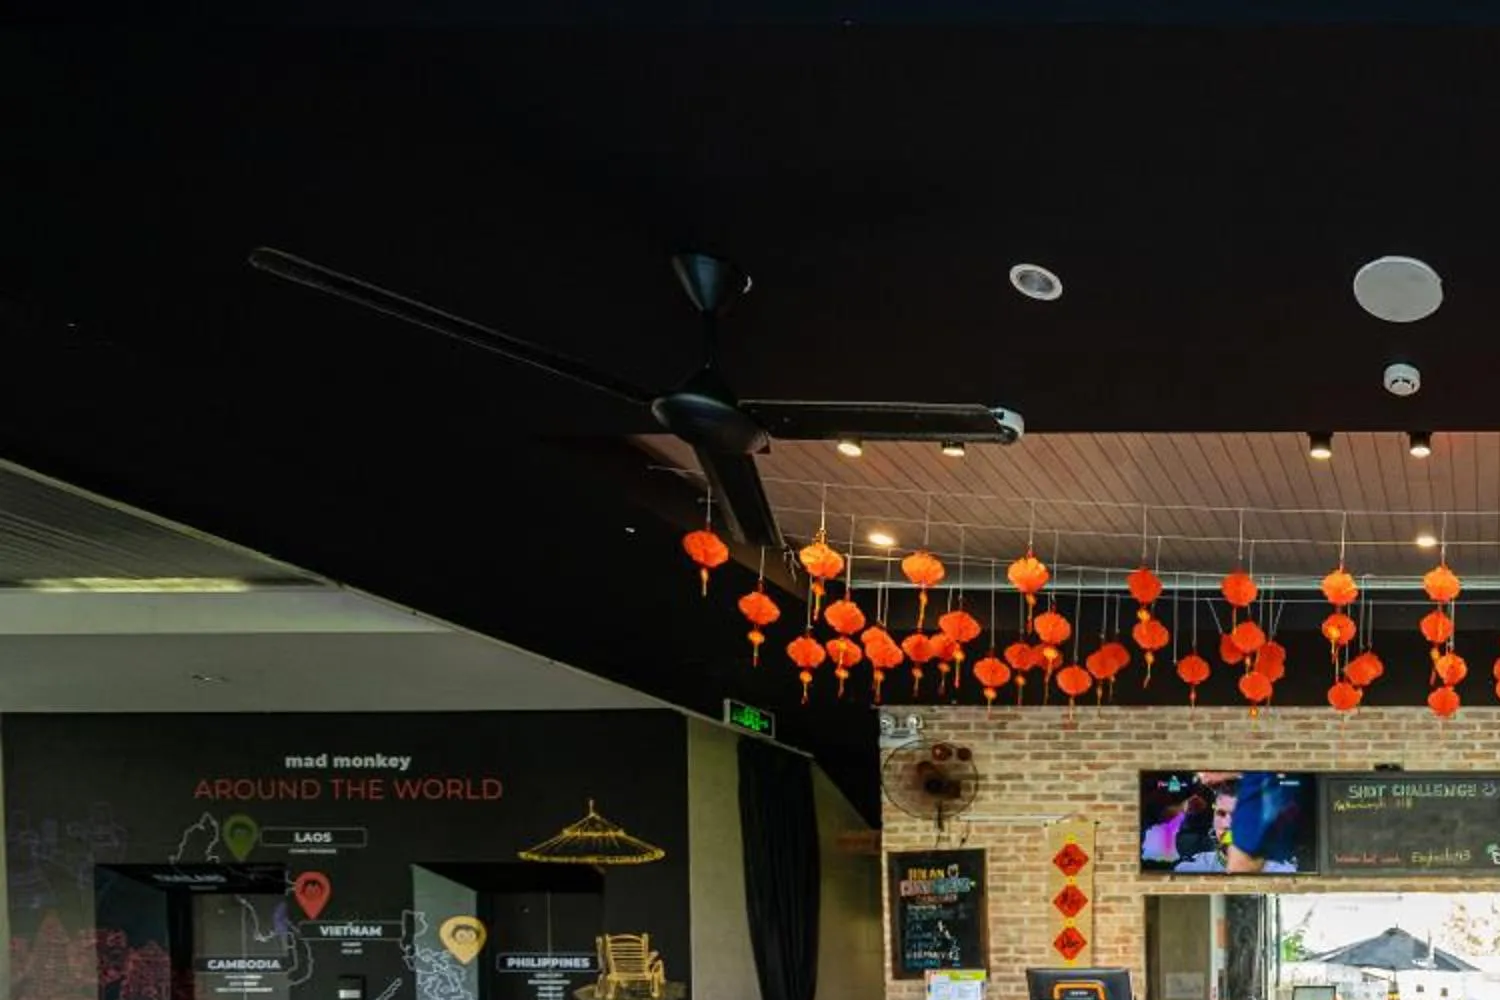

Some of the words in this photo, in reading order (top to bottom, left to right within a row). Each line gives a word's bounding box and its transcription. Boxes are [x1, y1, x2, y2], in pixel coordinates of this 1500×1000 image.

[285, 753, 327, 769] mad
[333, 753, 411, 771] monkey
[194, 778, 321, 800] AROUND
[330, 778, 385, 800] THE
[394, 778, 503, 800] WORLD
[1348, 784, 1387, 799] SHOT
[294, 831, 332, 843] LAOS
[319, 925, 382, 937] VIETNAM
[207, 958, 281, 970] CAMBODIA
[507, 957, 591, 969] PHILIPPINES
